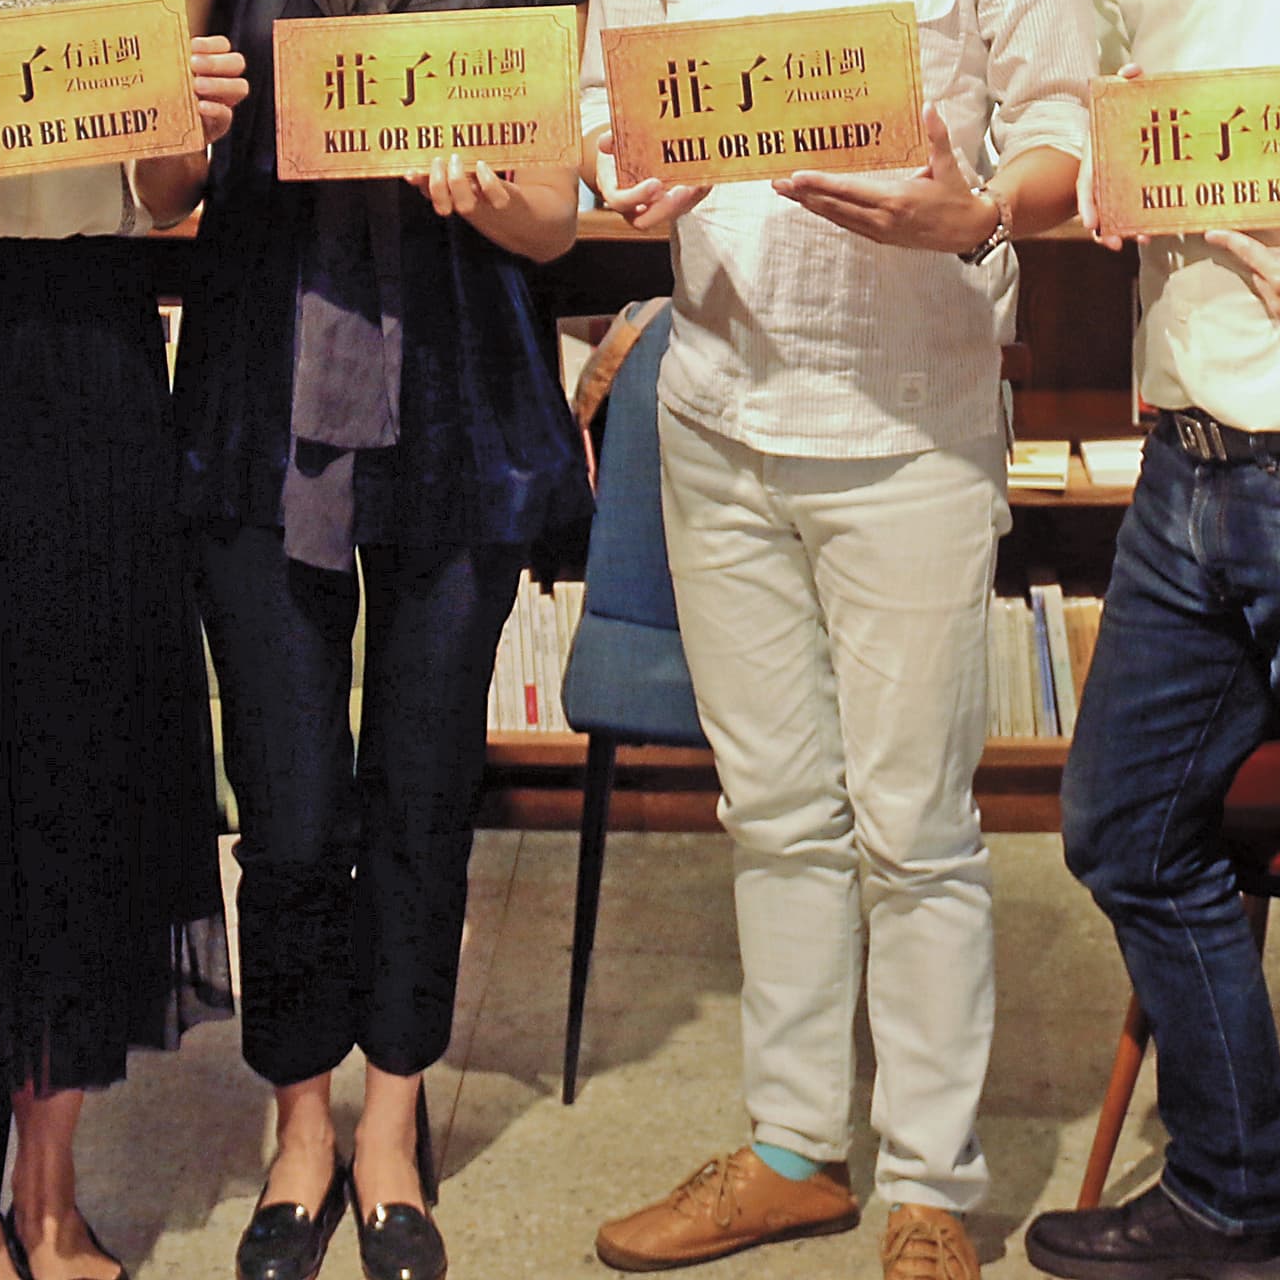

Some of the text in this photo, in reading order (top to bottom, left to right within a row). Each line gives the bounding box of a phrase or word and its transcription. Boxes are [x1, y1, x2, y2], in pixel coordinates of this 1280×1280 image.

[66, 70, 144, 92] Zhuangzi
[324, 51, 437, 110] 莊子
[448, 82, 526, 100] Zhuangzi
[658, 55, 774, 118] 莊子
[785, 82, 868, 103] Zhuangzi
[2, 124, 32, 150] OR
[39, 118, 68, 144] BE
[75, 108, 158, 140] KILLED?
[325, 121, 537, 153] KILL OR BE KILLED?
[662, 121, 882, 163] KILL OR BE KILLED?
[1140, 105, 1252, 165] 莊子
[1142, 185, 1187, 208] KILL
[1196, 182, 1225, 206] OR
[1233, 180, 1260, 204] BE
